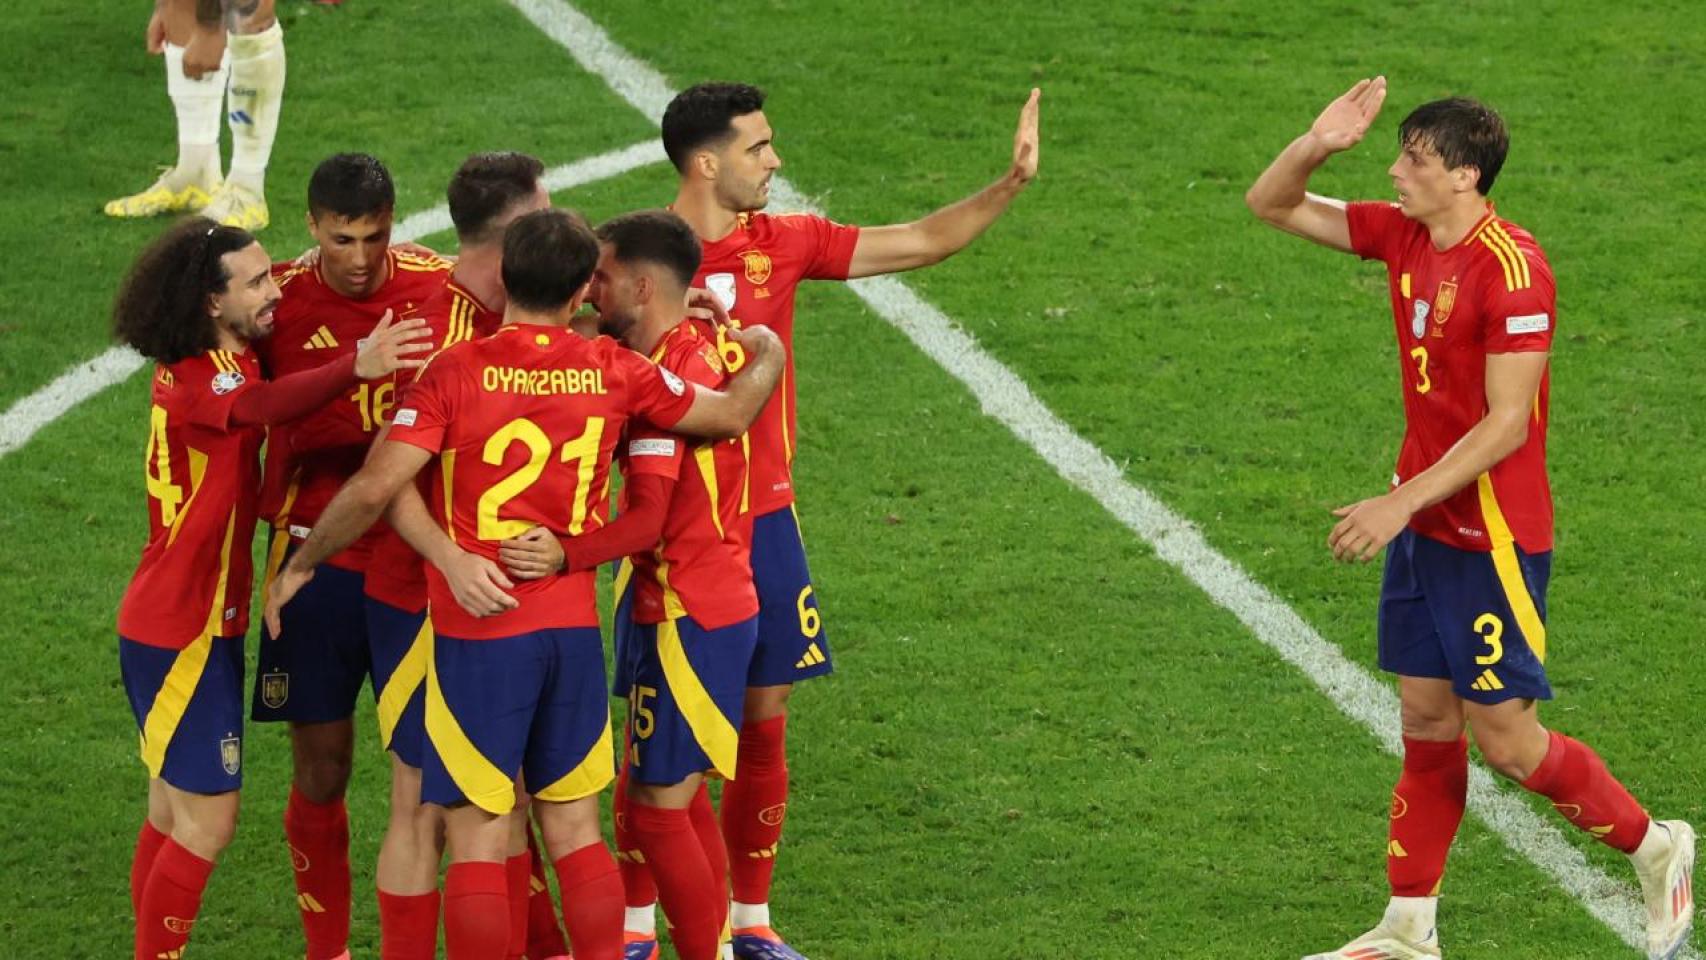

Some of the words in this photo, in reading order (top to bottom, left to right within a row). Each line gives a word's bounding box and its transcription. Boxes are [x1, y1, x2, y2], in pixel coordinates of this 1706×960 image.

[483, 365, 608, 396] OYARZABAL
[1410, 346, 1431, 394] 3
[477, 416, 605, 541] 21
[797, 585, 821, 639] 6
[1473, 612, 1503, 665] 3
